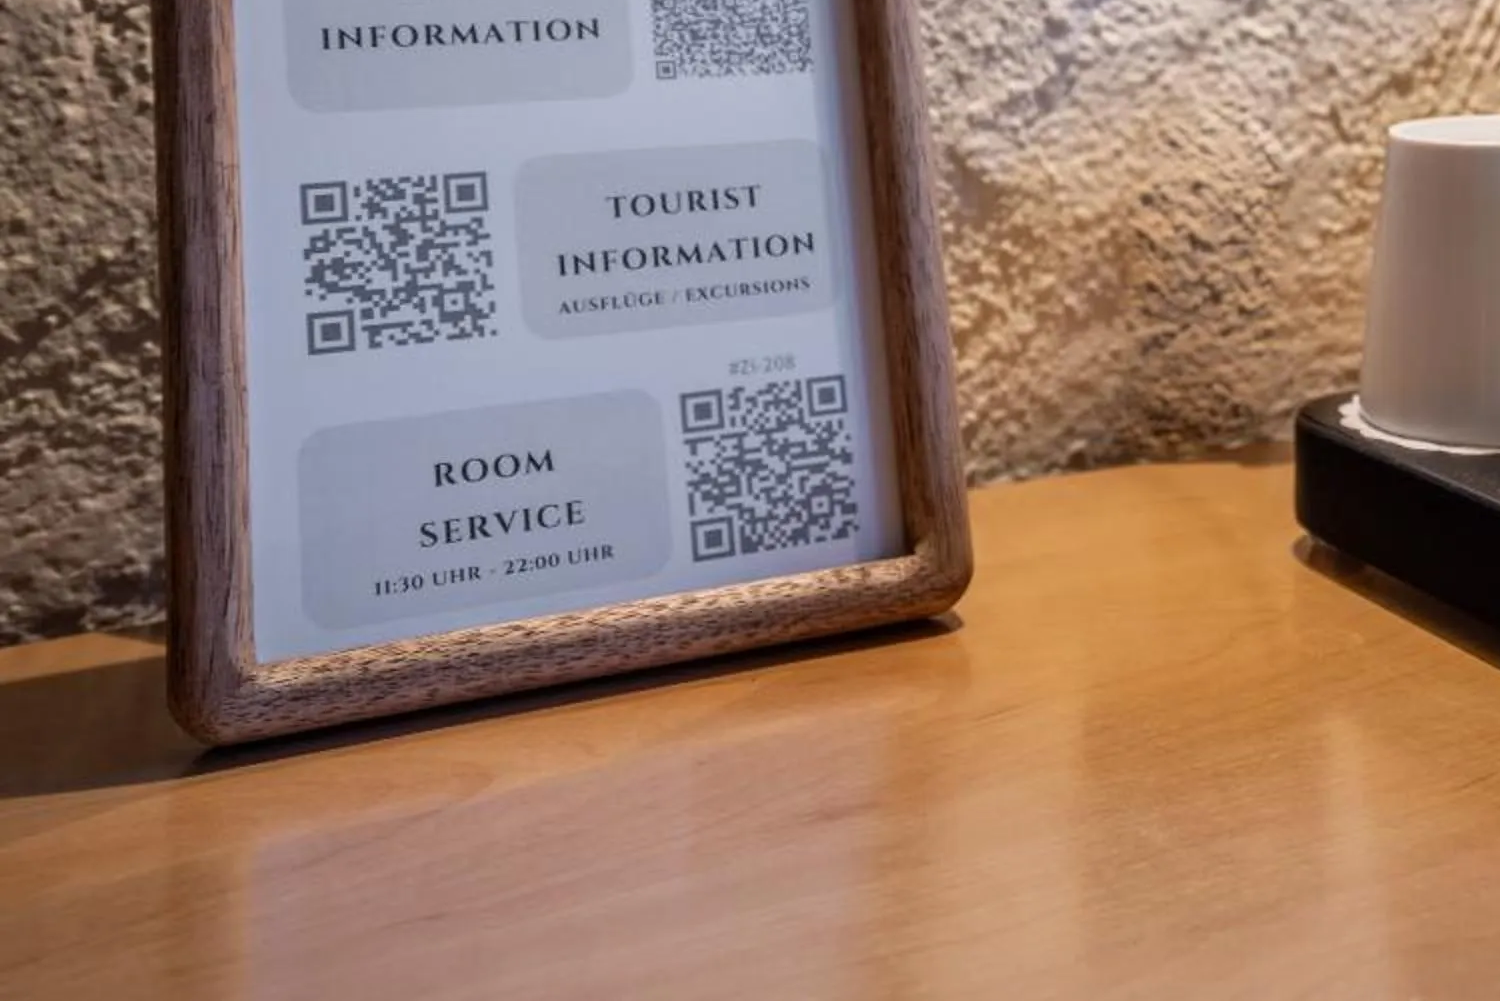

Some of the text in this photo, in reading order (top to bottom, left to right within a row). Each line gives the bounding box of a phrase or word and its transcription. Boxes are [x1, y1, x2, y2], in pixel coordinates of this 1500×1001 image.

[320, 17, 600, 51] INFORMATION
[605, 184, 762, 219] TOURIST
[557, 231, 815, 278] INFORMATION
[559, 290, 664, 315] AUSFLÜGE
[685, 276, 811, 302] EXCURSIONS
[432, 448, 556, 488] ROOM
[418, 500, 587, 549] SERVICE
[374, 575, 425, 597] 11:30
[431, 565, 482, 587] UHR
[504, 552, 561, 576] 22:00
[567, 544, 615, 565] UHR
